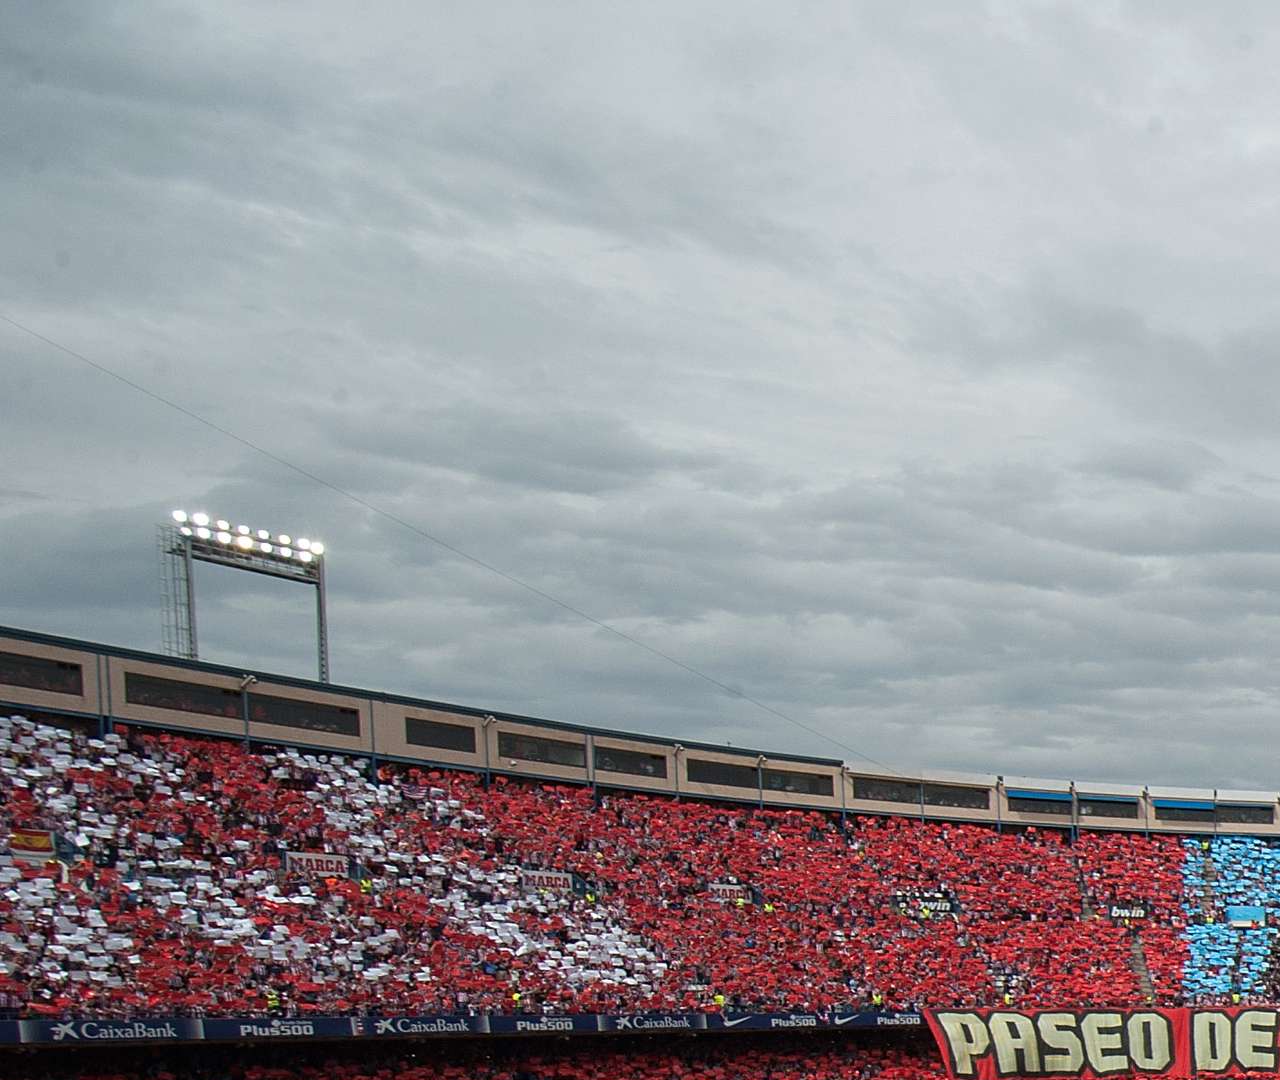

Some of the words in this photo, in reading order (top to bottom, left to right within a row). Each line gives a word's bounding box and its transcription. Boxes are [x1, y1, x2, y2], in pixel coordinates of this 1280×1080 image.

[290, 857, 345, 873] MARCA
[525, 874, 570, 889] MARCA
[397, 1018, 469, 1033] CaixaBank
[517, 1020, 573, 1031] Plus500
[633, 1016, 690, 1029] CaixaBank
[771, 1018, 817, 1027] Plus500
[877, 1016, 921, 1025] Plus500
[80, 1022, 177, 1039] CaixaBank
[240, 1024, 314, 1037] Plus500
[939, 1011, 1173, 1074] PASEO
[1192, 1010, 1277, 1069] DE
